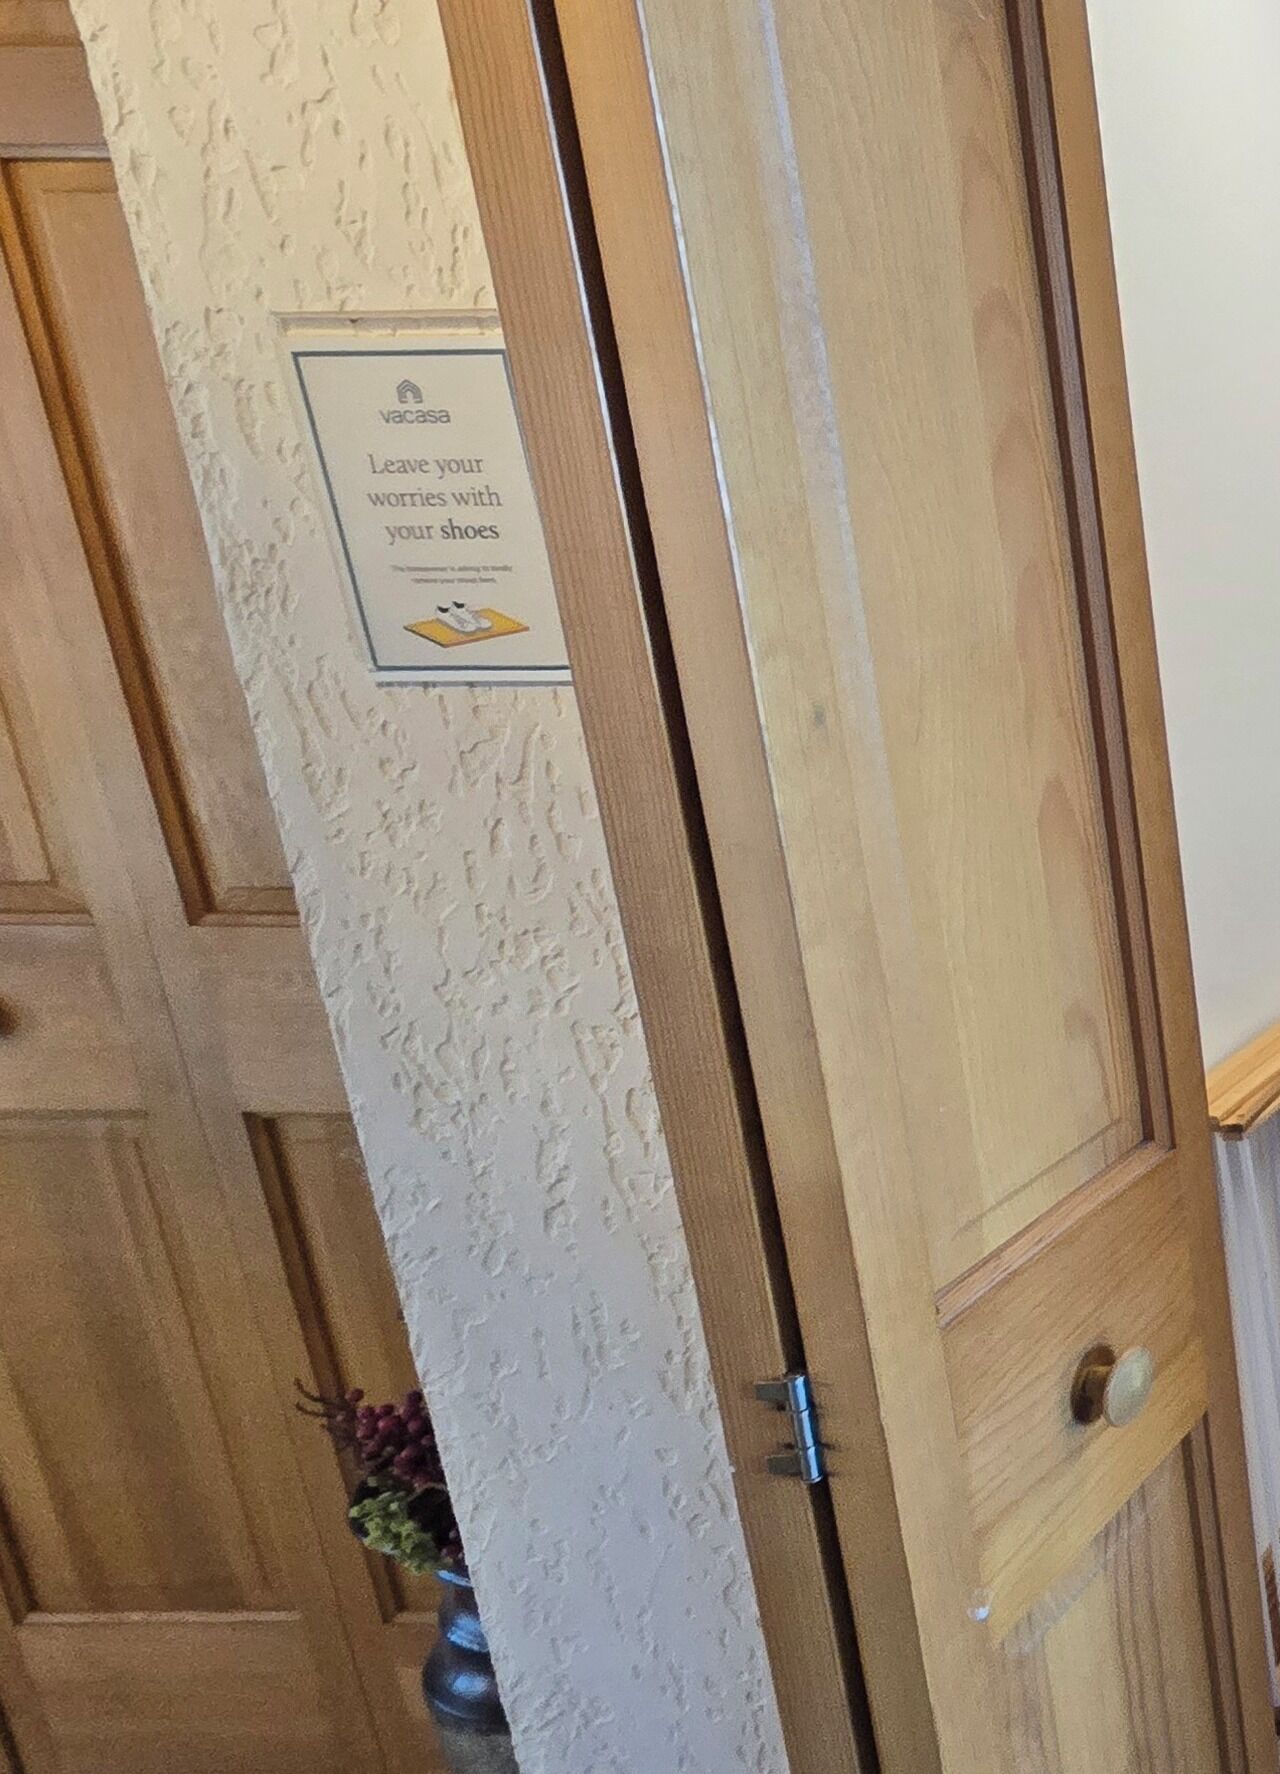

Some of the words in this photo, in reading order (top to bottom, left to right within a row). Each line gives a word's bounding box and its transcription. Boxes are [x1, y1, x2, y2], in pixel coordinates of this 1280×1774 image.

[378, 408, 452, 425] vacasa
[367, 453, 430, 474] Leave
[433, 457, 484, 480] your
[367, 487, 448, 507] worries
[451, 484, 503, 507] with
[385, 524, 434, 546] your
[440, 517, 500, 540] shoes
